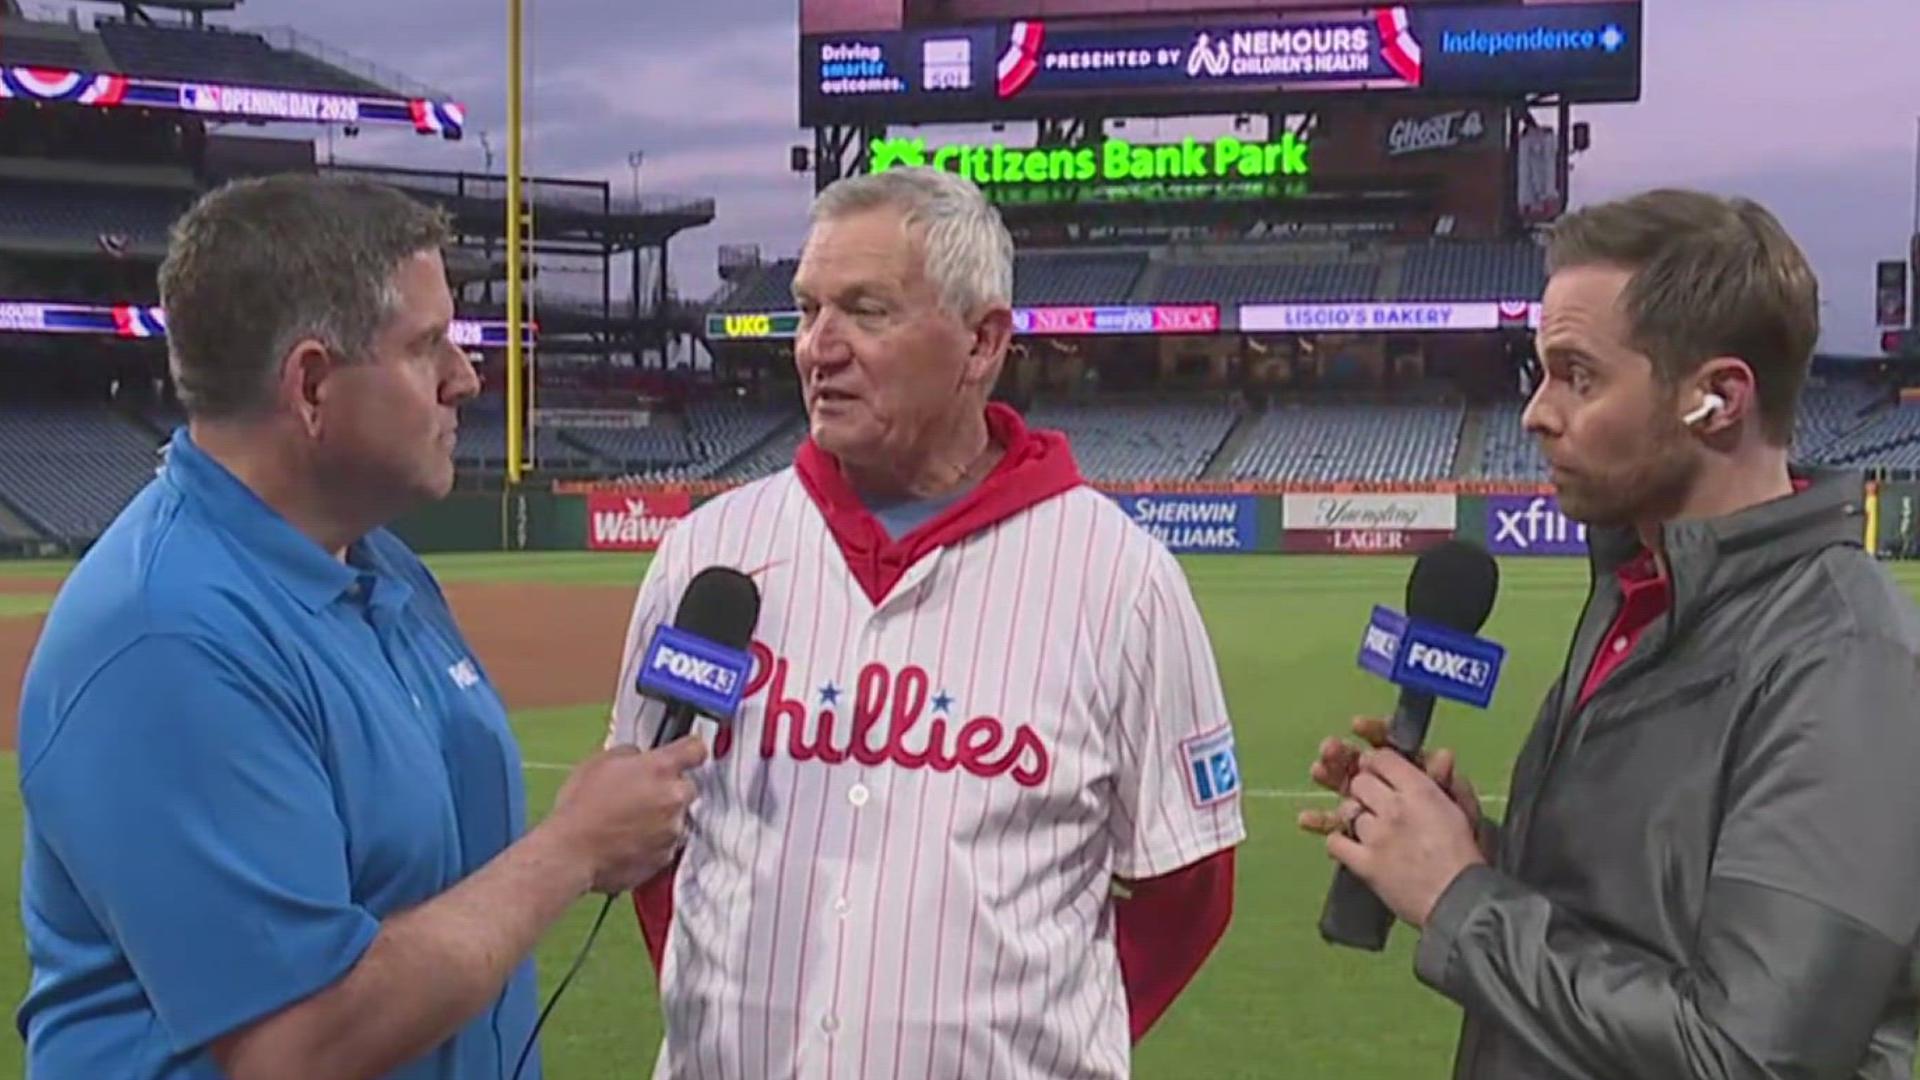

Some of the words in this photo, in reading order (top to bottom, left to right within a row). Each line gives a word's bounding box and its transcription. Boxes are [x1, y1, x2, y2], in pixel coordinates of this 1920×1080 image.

[822, 44, 881, 62] Driving
[1232, 27, 1369, 55] NEMOURS
[1442, 26, 1595, 56] Independence
[821, 61, 885, 78] smarter
[1045, 49, 1151, 69] PRESENTED
[1157, 49, 1181, 66] BY
[1232, 55, 1314, 75] CHILDREN'S
[1315, 53, 1369, 73] HEALTH
[821, 77, 905, 94] outcomes.
[221, 89, 288, 115] OPENING
[289, 94, 320, 119] DAY
[1388, 111, 1465, 155] GHOST
[933, 144, 1097, 183] Citizens
[1102, 136, 1208, 179] Bank
[1214, 132, 1308, 174] Park
[1285, 308, 1367, 326] LISCIO'S
[1373, 307, 1453, 325] BAKERY
[1134, 497, 1238, 523] SHERWIN
[1333, 530, 1403, 549] LAGER
[652, 645, 738, 696] FOX43
[1407, 641, 1491, 688] FOX43
